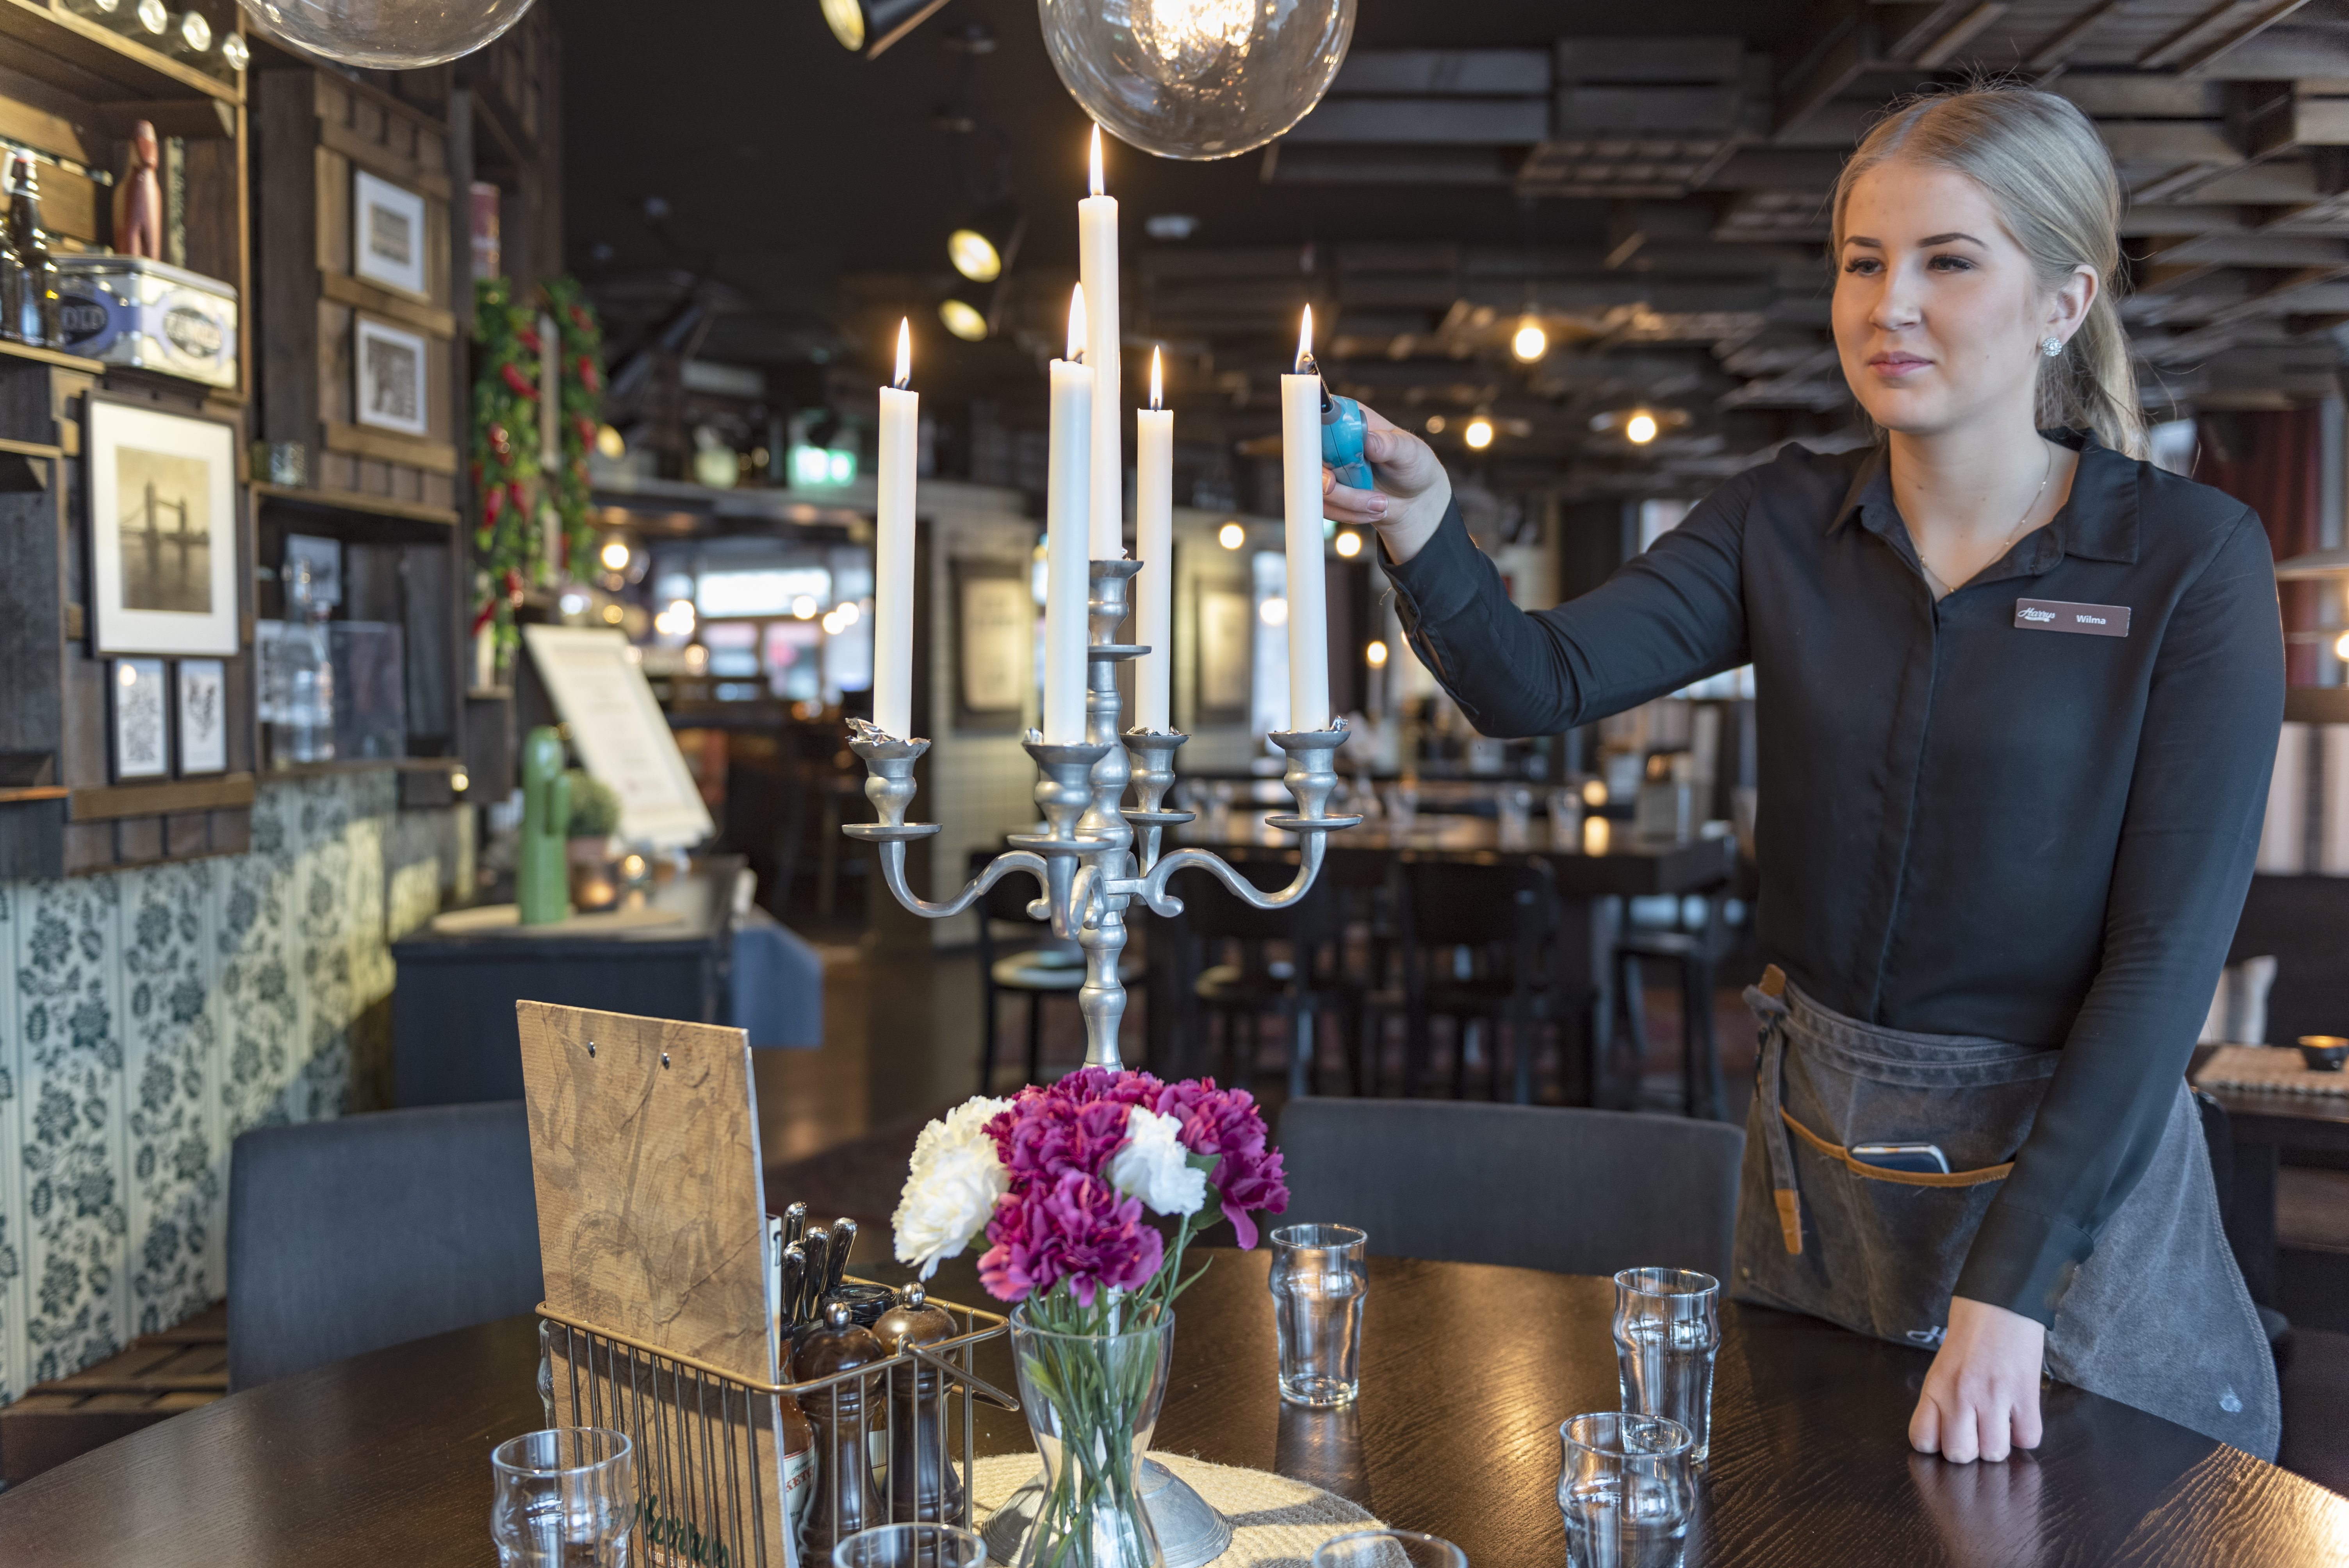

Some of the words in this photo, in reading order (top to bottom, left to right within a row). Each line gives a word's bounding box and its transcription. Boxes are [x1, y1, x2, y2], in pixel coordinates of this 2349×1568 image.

[2018, 607, 2055, 619] Harrys
[2076, 615, 2106, 625] Wilma
[786, 1465, 814, 1493] KETC
[652, 1550, 667, 1564] GOT
